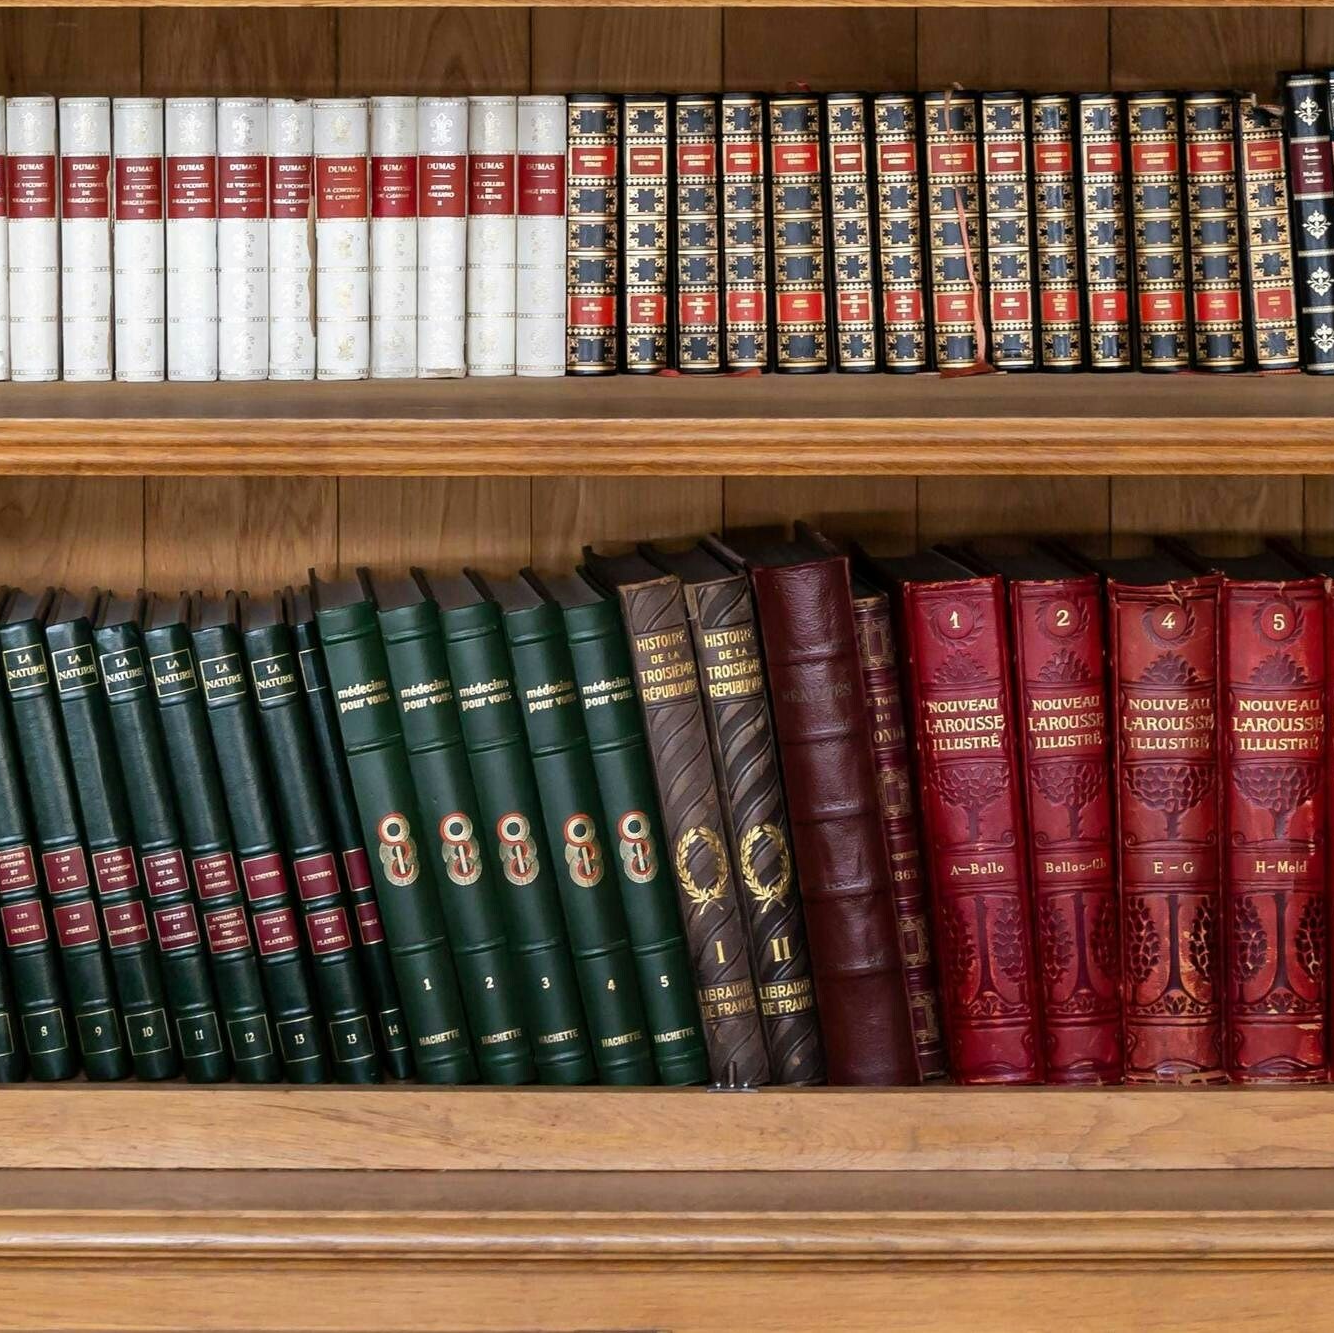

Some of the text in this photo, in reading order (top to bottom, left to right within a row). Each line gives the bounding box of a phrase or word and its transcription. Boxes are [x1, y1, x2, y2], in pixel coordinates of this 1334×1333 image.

[949, 611, 960, 628] 1
[1056, 610, 1070, 626] 2
[1161, 612, 1175, 628] 4
[1273, 614, 1285, 631] 5
[637, 630, 687, 652] HISTOIRE
[115, 657, 129, 667] LA
[651, 650, 680, 664] DE LA
[106, 669, 143, 683] NATURE
[642, 679, 699, 703] RÉPUBLIQUE
[461, 692, 512, 712] pour vous
[928, 698, 999, 713] NOUVEAU
[925, 714, 1006, 734] LAROUSSE
[932, 733, 1002, 751] ILLUSTRÉ
[1255, 861, 1308, 873] H-Meld
[714, 940, 727, 964] I
[771, 936, 792, 961] II
[424, 979, 432, 991] 1
[486, 978, 494, 989] 2
[661, 976, 669, 988] 5
[699, 981, 753, 1002] LIBRAIRIE
[702, 995, 755, 1018] DE FRANCE
[41, 1026, 48, 1037] 8
[142, 1026, 153, 1037] 10
[388, 1025, 399, 1036] 14
[419, 1029, 460, 1045] HACHETTE
